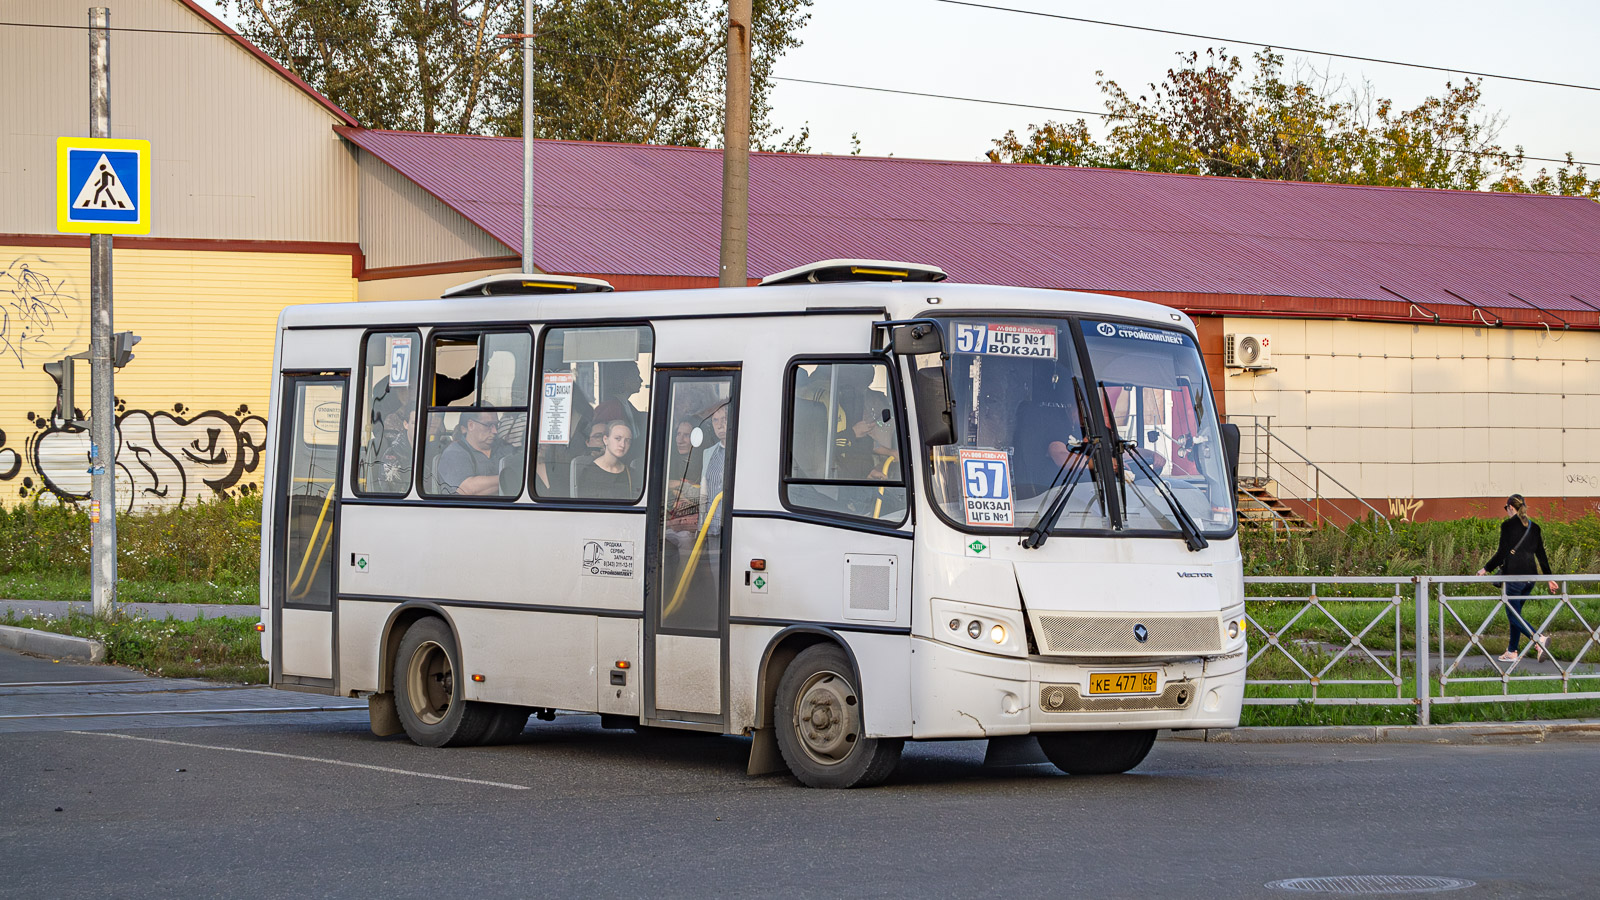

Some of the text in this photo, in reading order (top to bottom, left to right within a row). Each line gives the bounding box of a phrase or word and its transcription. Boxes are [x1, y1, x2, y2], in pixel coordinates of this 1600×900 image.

[957, 323, 986, 352] 57
[994, 332, 1046, 346] ЦГБ №1
[1118, 329, 1183, 345] СТРОЙКОМПЛЕКТ
[988, 344, 1051, 357] ВОКЗАЛ
[392, 347, 409, 381] 57
[545, 385, 556, 397] 57
[966, 461, 1004, 497] 57
[967, 500, 1011, 511] ВОКЗАЛ
[971, 511, 1009, 522] ЦГБ №1
[1095, 673, 1153, 691] КЕ 477 66
